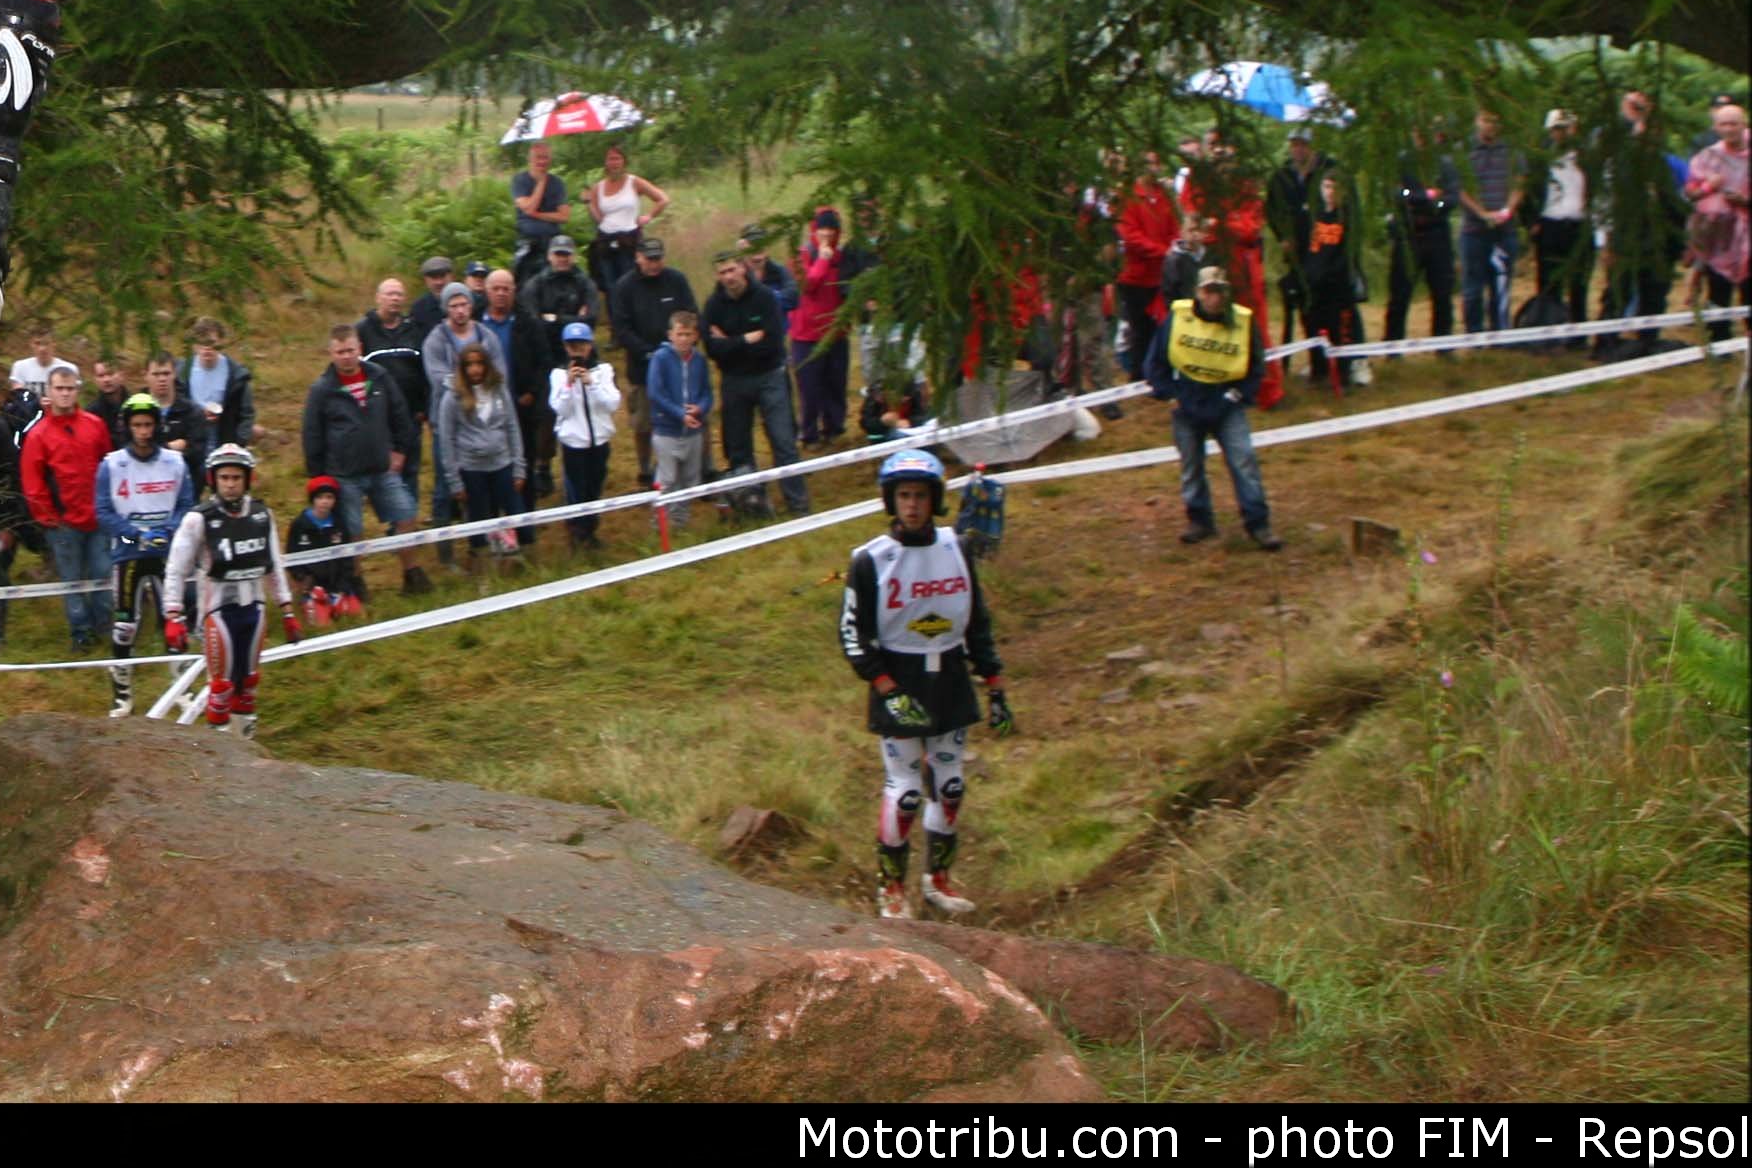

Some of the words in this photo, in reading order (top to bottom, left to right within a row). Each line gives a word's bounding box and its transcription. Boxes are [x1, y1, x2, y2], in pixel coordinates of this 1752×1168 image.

[116, 479, 130, 500] 4
[218, 537, 233, 562] 1
[886, 577, 904, 610] 2
[911, 576, 968, 600] RAGA
